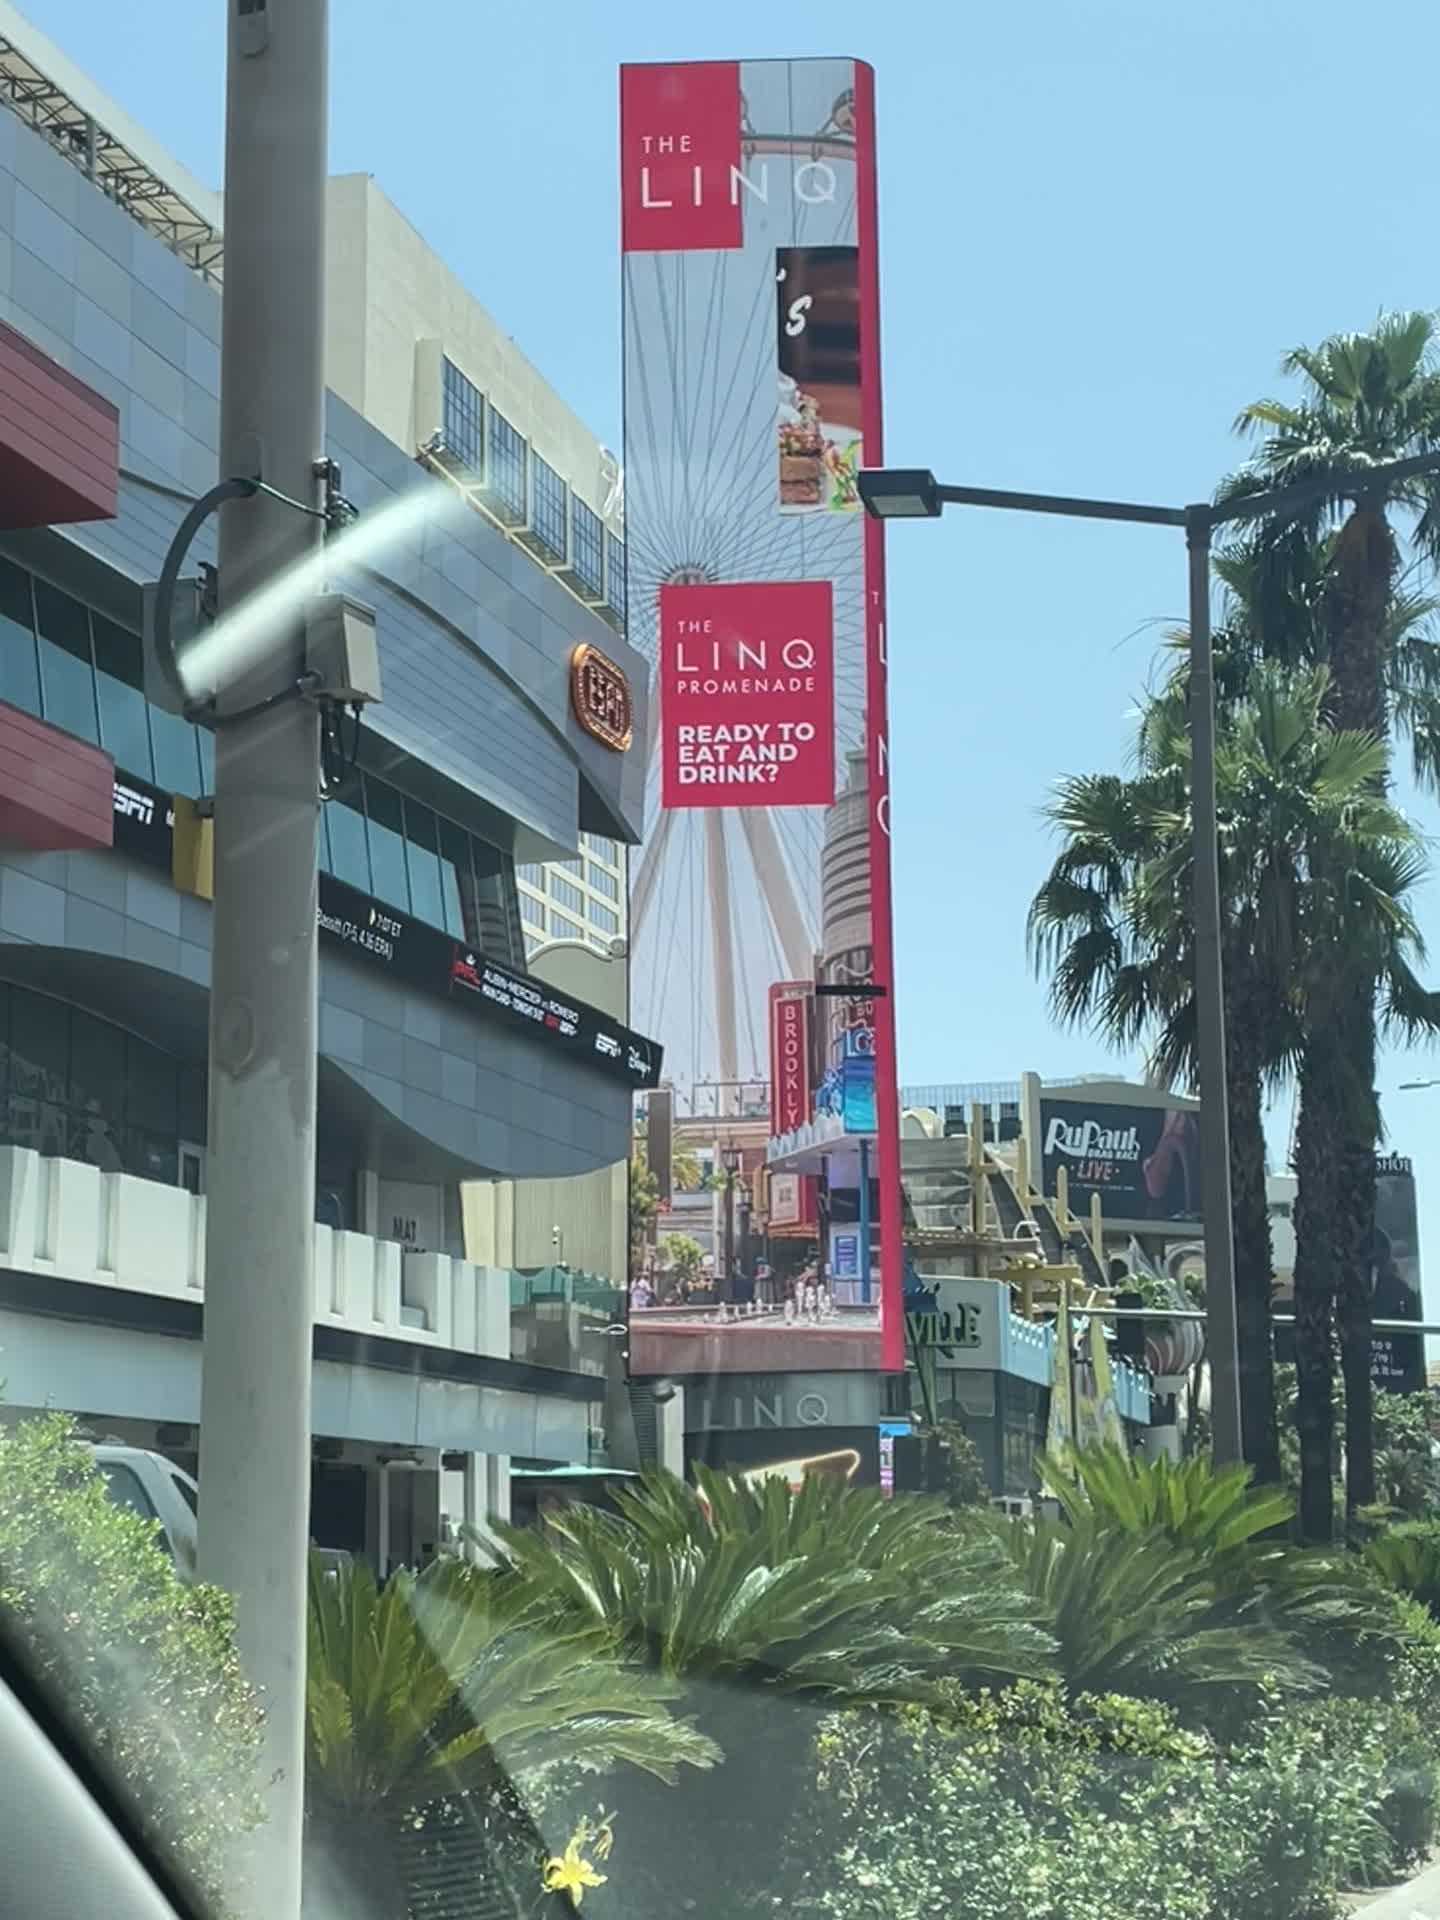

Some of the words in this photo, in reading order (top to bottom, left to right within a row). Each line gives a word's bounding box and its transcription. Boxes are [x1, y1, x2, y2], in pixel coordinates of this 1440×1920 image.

[641, 135, 692, 154] THE
[641, 161, 837, 208] LINQ
[677, 619, 713, 633] THE
[676, 638, 815, 672] LINQ
[677, 676, 815, 695] PROMENADE
[678, 723, 770, 744] READY
[778, 722, 815, 742] TO
[678, 744, 730, 764] EAT
[738, 743, 799, 763] AND
[678, 764, 780, 784] DRINK?
[784, 1005, 799, 1126] BROOKLY
[702, 1393, 828, 1431] LINQ
